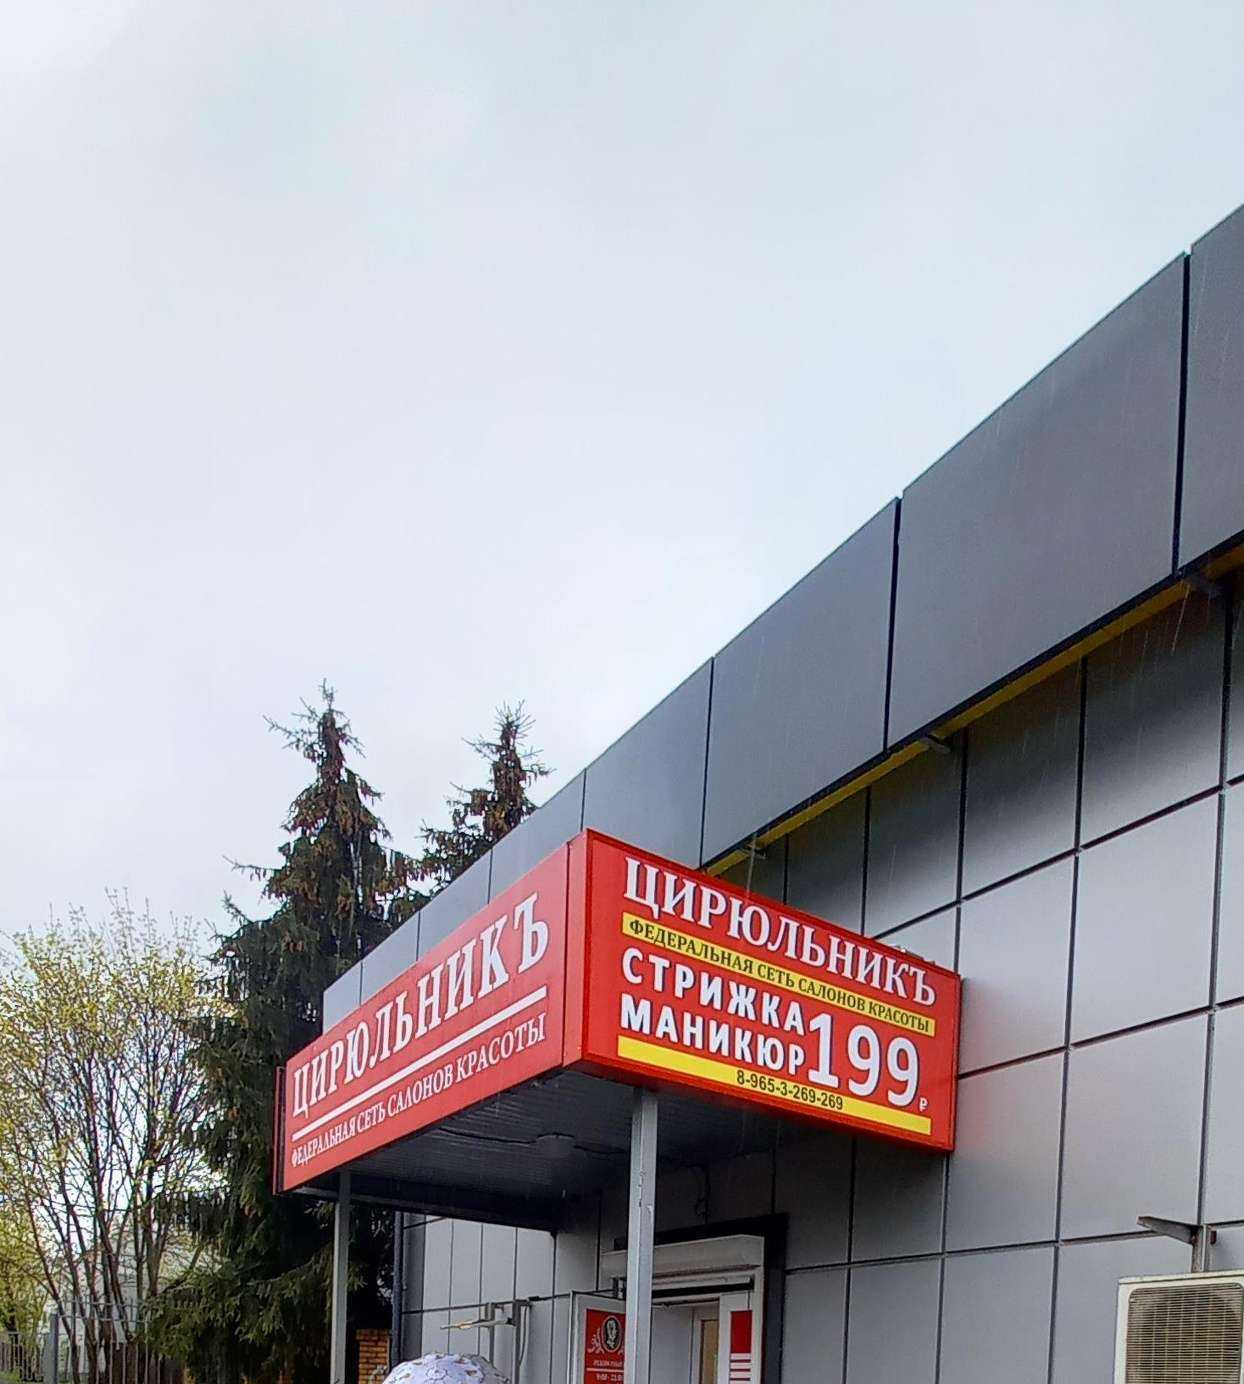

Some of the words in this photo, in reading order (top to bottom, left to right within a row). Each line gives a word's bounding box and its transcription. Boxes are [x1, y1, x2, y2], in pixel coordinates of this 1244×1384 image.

[623, 856, 936, 1007] ЦИРЮЛЬНИКЪ
[630, 919, 753, 975] ФЕДЕРАЛЬНАЯ
[757, 963, 795, 989] СЕТЬ
[798, 978, 866, 1012] САЛОНОВ
[868, 1003, 930, 1033] КРАСОТЫ
[292, 892, 550, 1119] ЦИРЮЛЬНИКЪ
[620, 993, 805, 1075] МАНИКЮР
[621, 947, 805, 1036] СТРИЖКА
[291, 1119, 357, 1167] ФЕДЕРАЛЬНАЯ
[357, 1106, 386, 1141] СЕТЬ
[387, 1064, 453, 1118] САЛОНОВ
[456, 1012, 547, 1085] КРАСОТЫ
[736, 1070, 844, 1111] 8-965-3-269-269
[808, 1012, 920, 1107] 199
